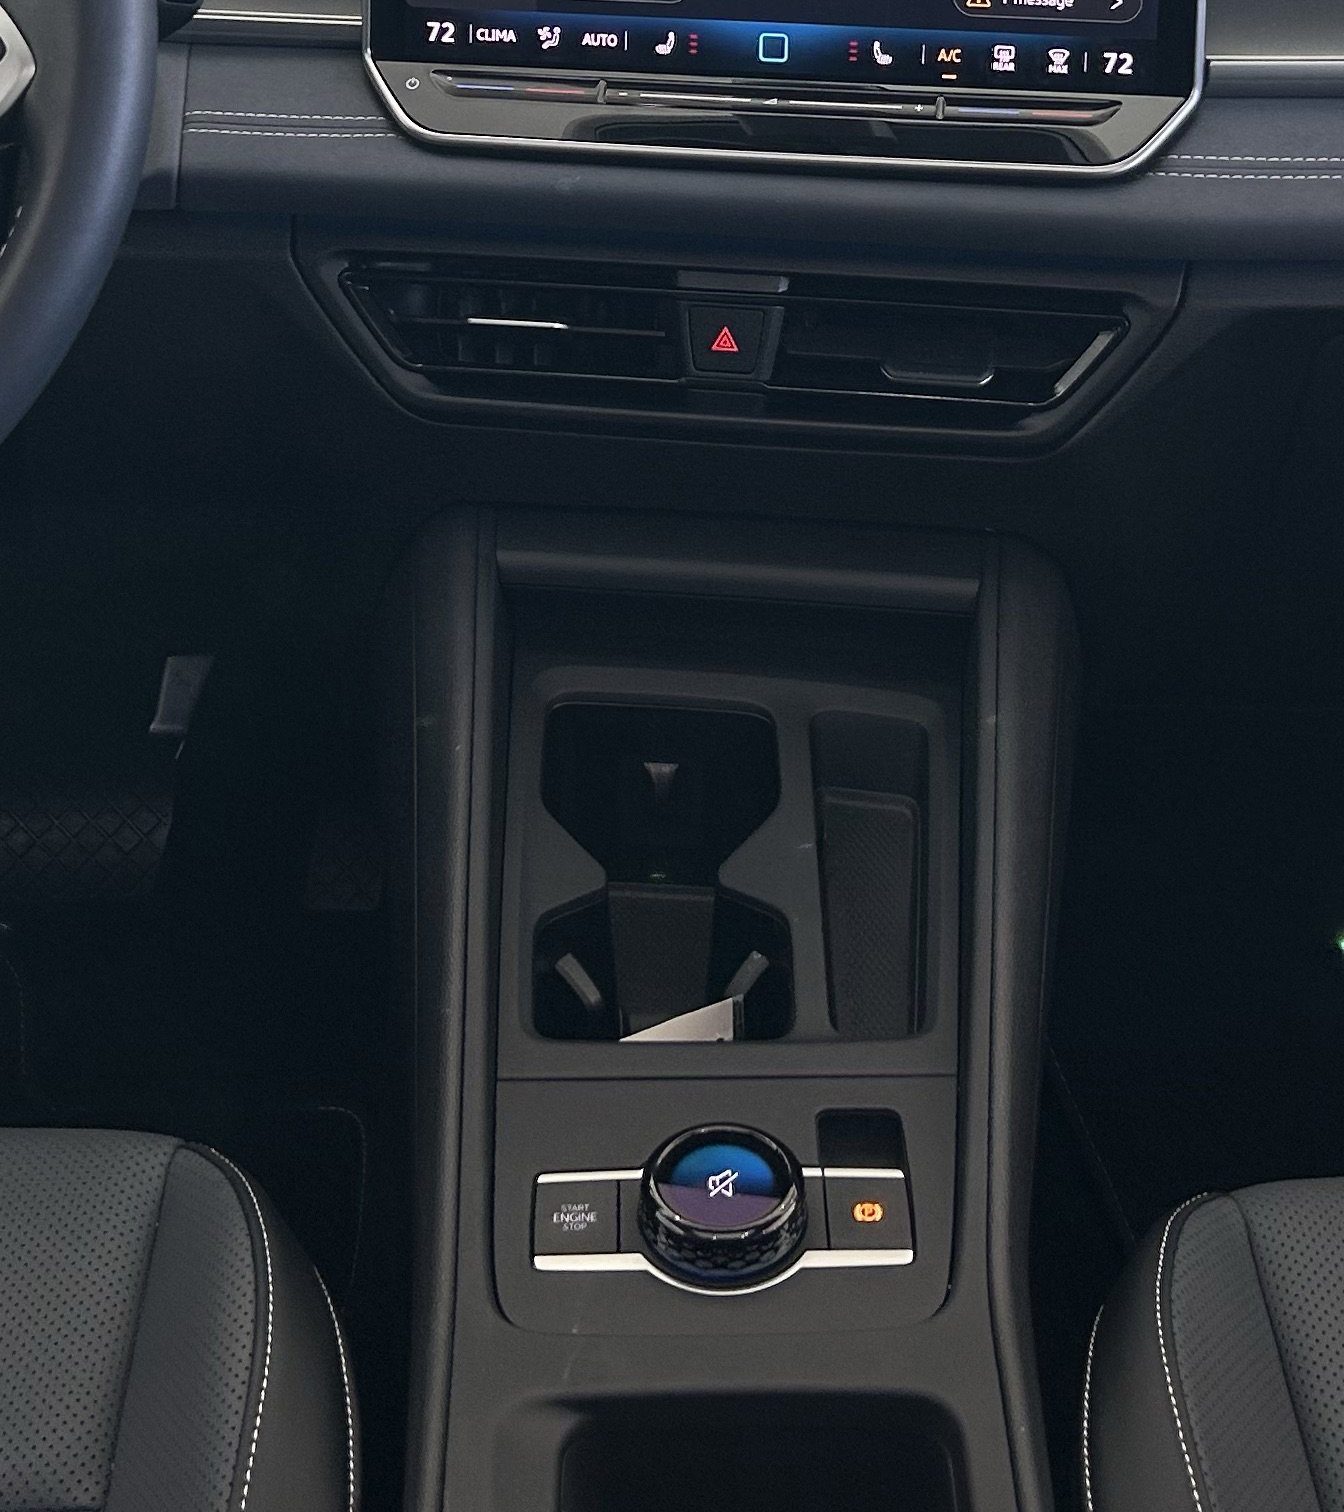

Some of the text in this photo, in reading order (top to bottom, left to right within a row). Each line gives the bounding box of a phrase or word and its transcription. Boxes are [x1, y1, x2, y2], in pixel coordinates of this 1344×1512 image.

[426, 21, 455, 43] 72
[476, 28, 516, 43] CLIMA
[582, 33, 618, 47] AUTO
[937, 48, 961, 63] A/C
[1103, 52, 1134, 75] 72
[561, 1204, 589, 1212] START
[553, 1212, 597, 1223] ENGINE
[562, 1222, 587, 1231] STOP
